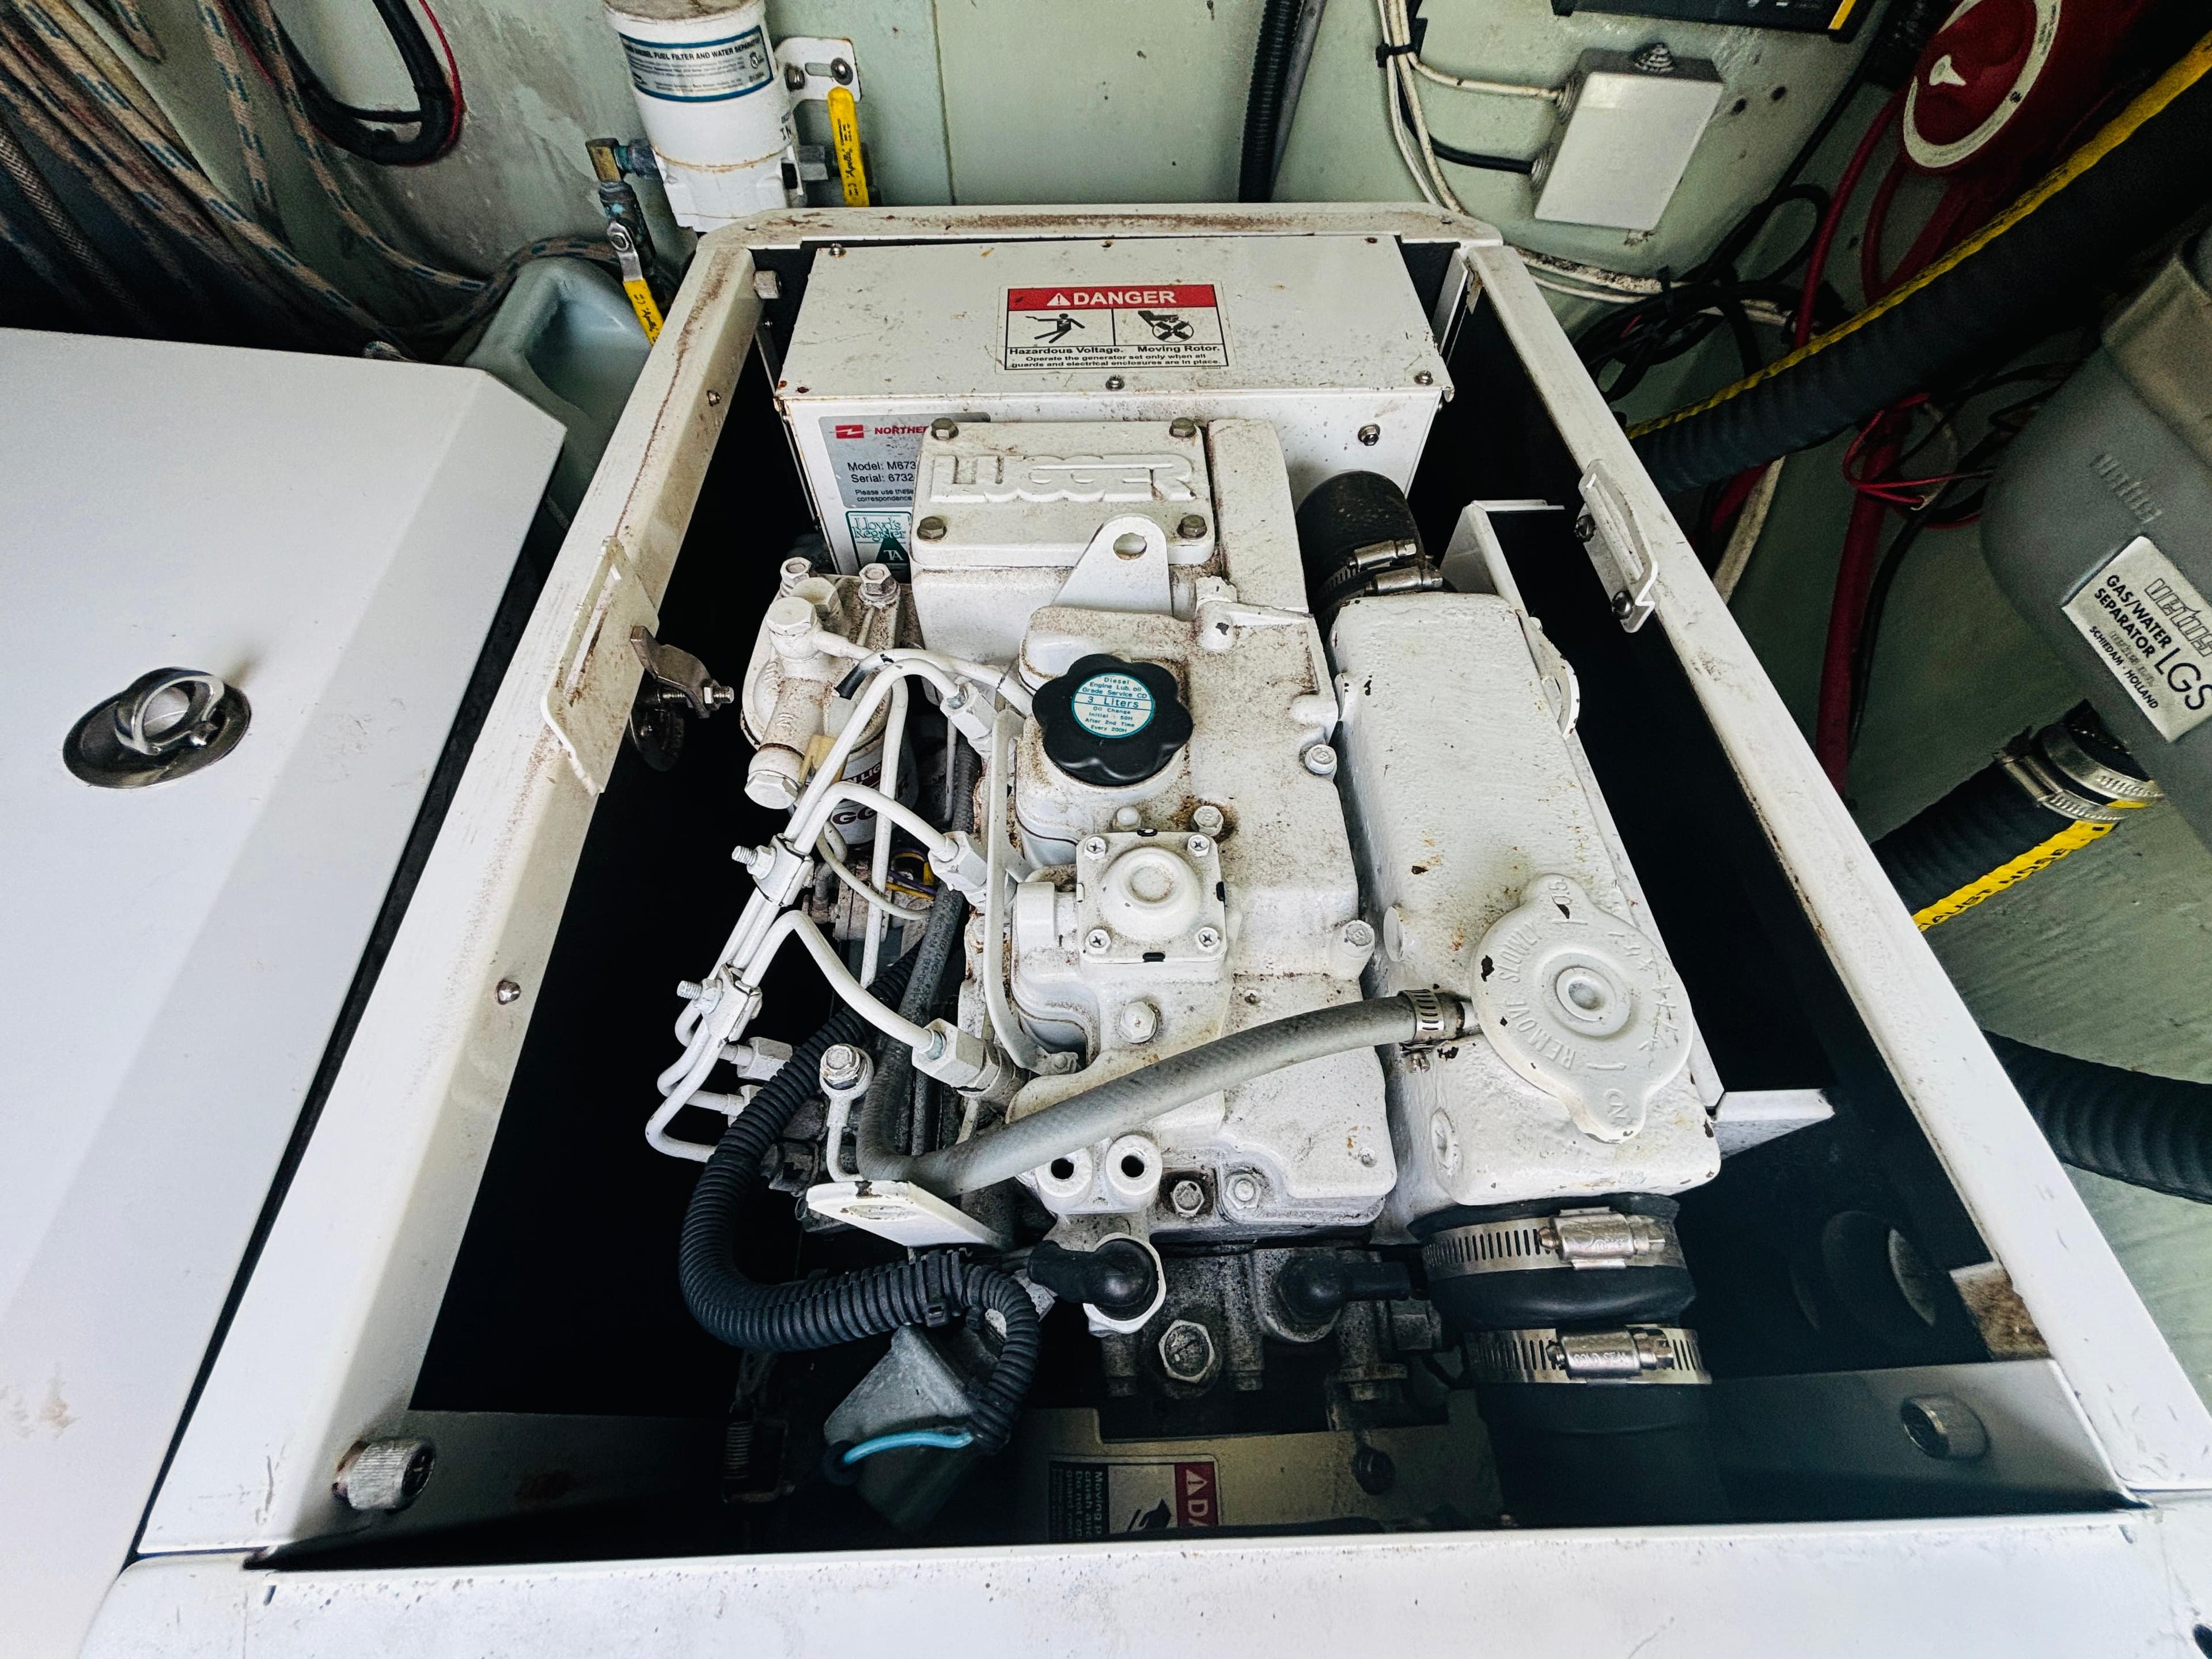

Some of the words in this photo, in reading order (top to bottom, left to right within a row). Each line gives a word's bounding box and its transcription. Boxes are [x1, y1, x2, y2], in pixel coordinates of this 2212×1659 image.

[654, 51, 670, 60] FUEL
[672, 53, 694, 61] FILTER
[712, 48, 733, 58] WATER
[1073, 290, 1176, 305] DANGER
[847, 461, 884, 472] Model:
[887, 461, 916, 471] M673
[851, 474, 885, 483] Serial:
[888, 474, 914, 482] 6732
[854, 517, 901, 531] Lloyd's
[851, 527, 906, 542] Register
[2106, 575, 2172, 649] GAS/WATER
[2094, 588, 2156, 659] SEPARATOR
[2089, 626, 2124, 666] SCHIEDAM
[2124, 669, 2159, 709] HOLLAND
[2154, 647, 2212, 710] LGS
[1104, 696, 1139, 708] Liters
[1506, 1000, 1575, 1070] REMOVE
[1094, 1471, 1103, 1521] Moving
